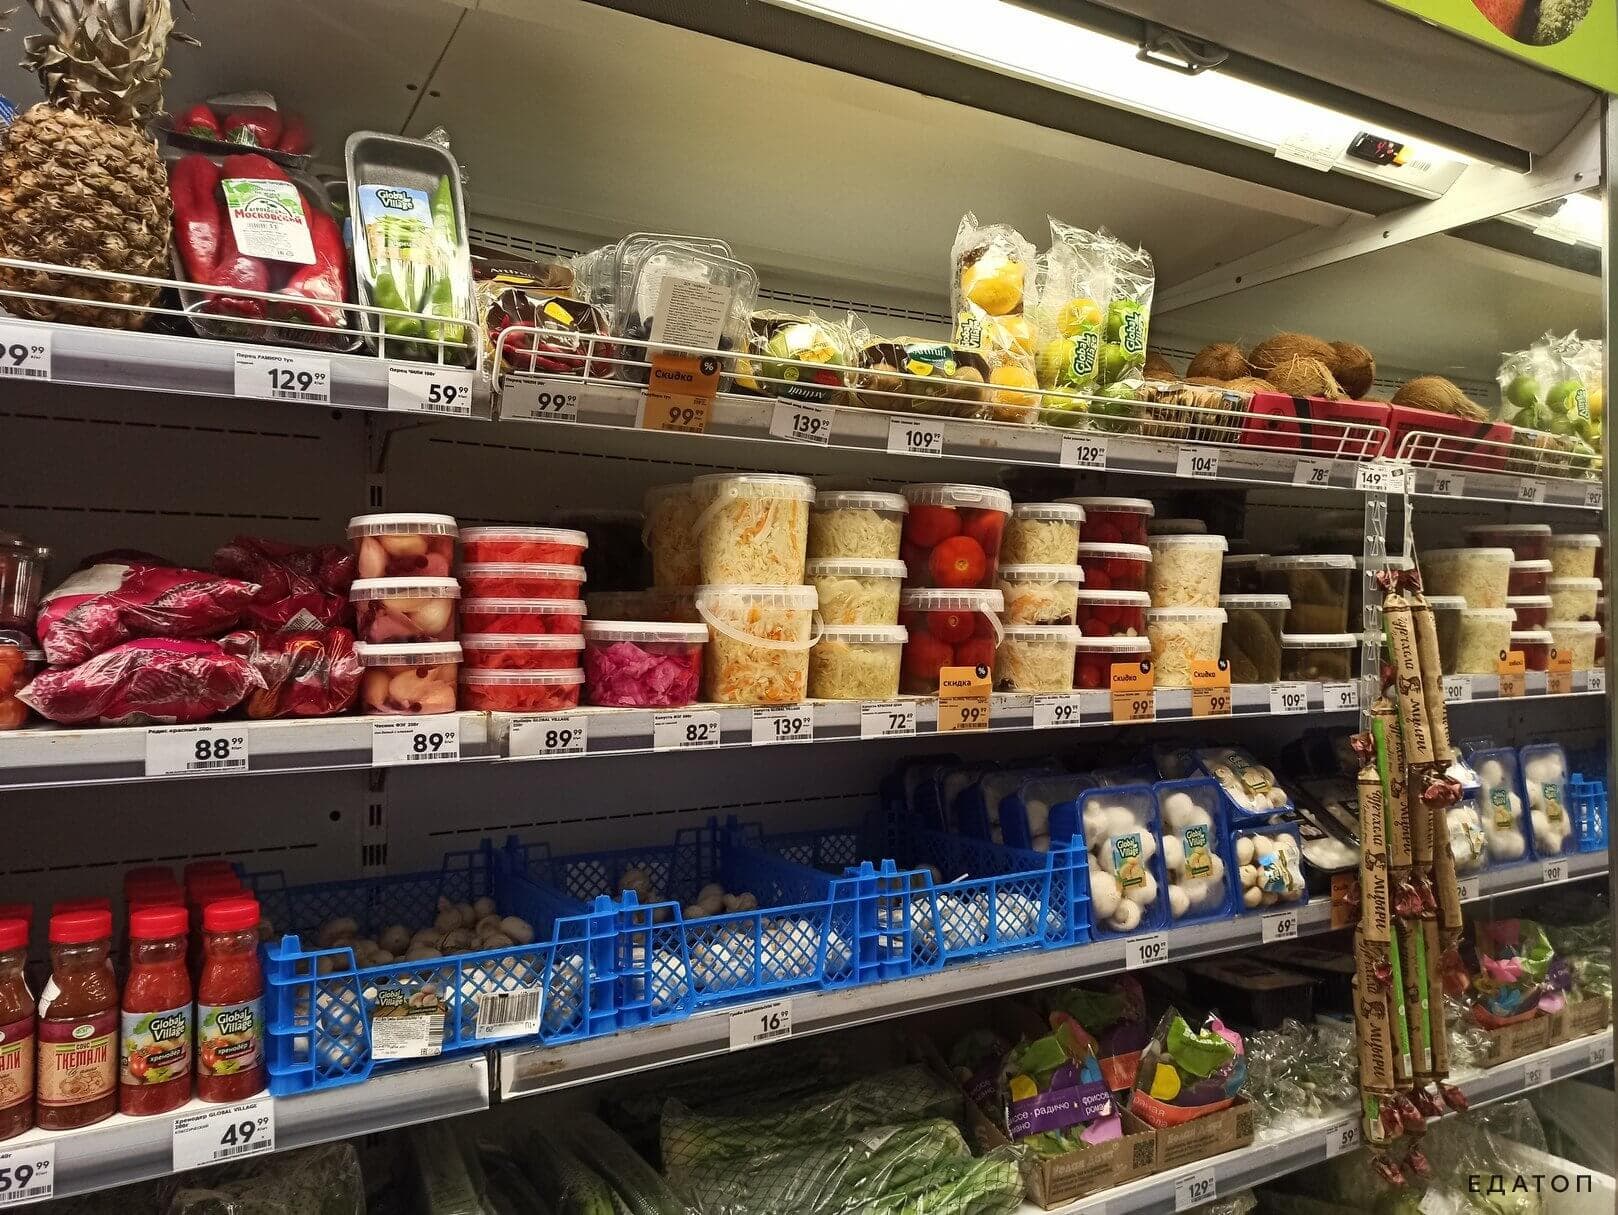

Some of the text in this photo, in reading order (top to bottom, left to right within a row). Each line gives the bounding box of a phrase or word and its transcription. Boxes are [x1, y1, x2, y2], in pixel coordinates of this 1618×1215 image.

[376, 188, 411, 201] Global
[381, 197, 415, 211] Village
[1125, 312, 1141, 352] Global
[31, 345, 45, 354] 99
[1074, 332, 1094, 375] Global
[1083, 333, 1100, 375] Village
[267, 368, 326, 392] 129 99
[655, 369, 693, 382] Скидка
[428, 383, 469, 404] 59 99
[537, 392, 577, 412] 99 99
[669, 407, 694, 425] 99
[792, 413, 830, 434] 139 99
[905, 430, 933, 447] 109
[1076, 445, 1098, 462] 129
[1191, 457, 1211, 471] 104
[1311, 468, 1324, 481] 78
[1361, 472, 1381, 484] 149
[1112, 674, 1137, 683] Скидка
[1193, 670, 1216, 678] Скидка
[1210, 697, 1225, 710] 99
[1281, 694, 1301, 707] 109
[1340, 692, 1352, 704] 91
[960, 707, 980, 723] 99
[1054, 705, 1072, 720] 99
[1132, 700, 1149, 714] 99
[773, 718, 803, 735] 139
[888, 714, 906, 729] 72
[545, 730, 572, 748] 89
[686, 723, 708, 741] 82
[195, 737, 243, 760] 88 99
[413, 733, 443, 753] 89
[1184, 827, 1205, 839] Global
[1116, 837, 1137, 849] Global
[1186, 835, 1207, 848] Village
[1118, 845, 1140, 858] Village
[1277, 919, 1291, 933] 69
[1138, 943, 1160, 960] 109
[378, 989, 402, 999] Global
[380, 995, 405, 1006] Village
[150, 1014, 184, 1031] Global
[217, 1008, 250, 1024] Global
[760, 1013, 781, 1032] 16
[153, 1024, 185, 1042] Village
[220, 1019, 252, 1035] Village
[55, 1045, 107, 1071] ТКЕМАЛИ
[208, 1109, 232, 1118] GLOBAL
[233, 1103, 258, 1113] VILLAGE
[1034, 1101, 1070, 1117] радиччо
[220, 1116, 269, 1146] 49 99
[1341, 1129, 1354, 1145] 59
[0, 1160, 49, 1192] 59 99
[1188, 1180, 1208, 1198] 129
